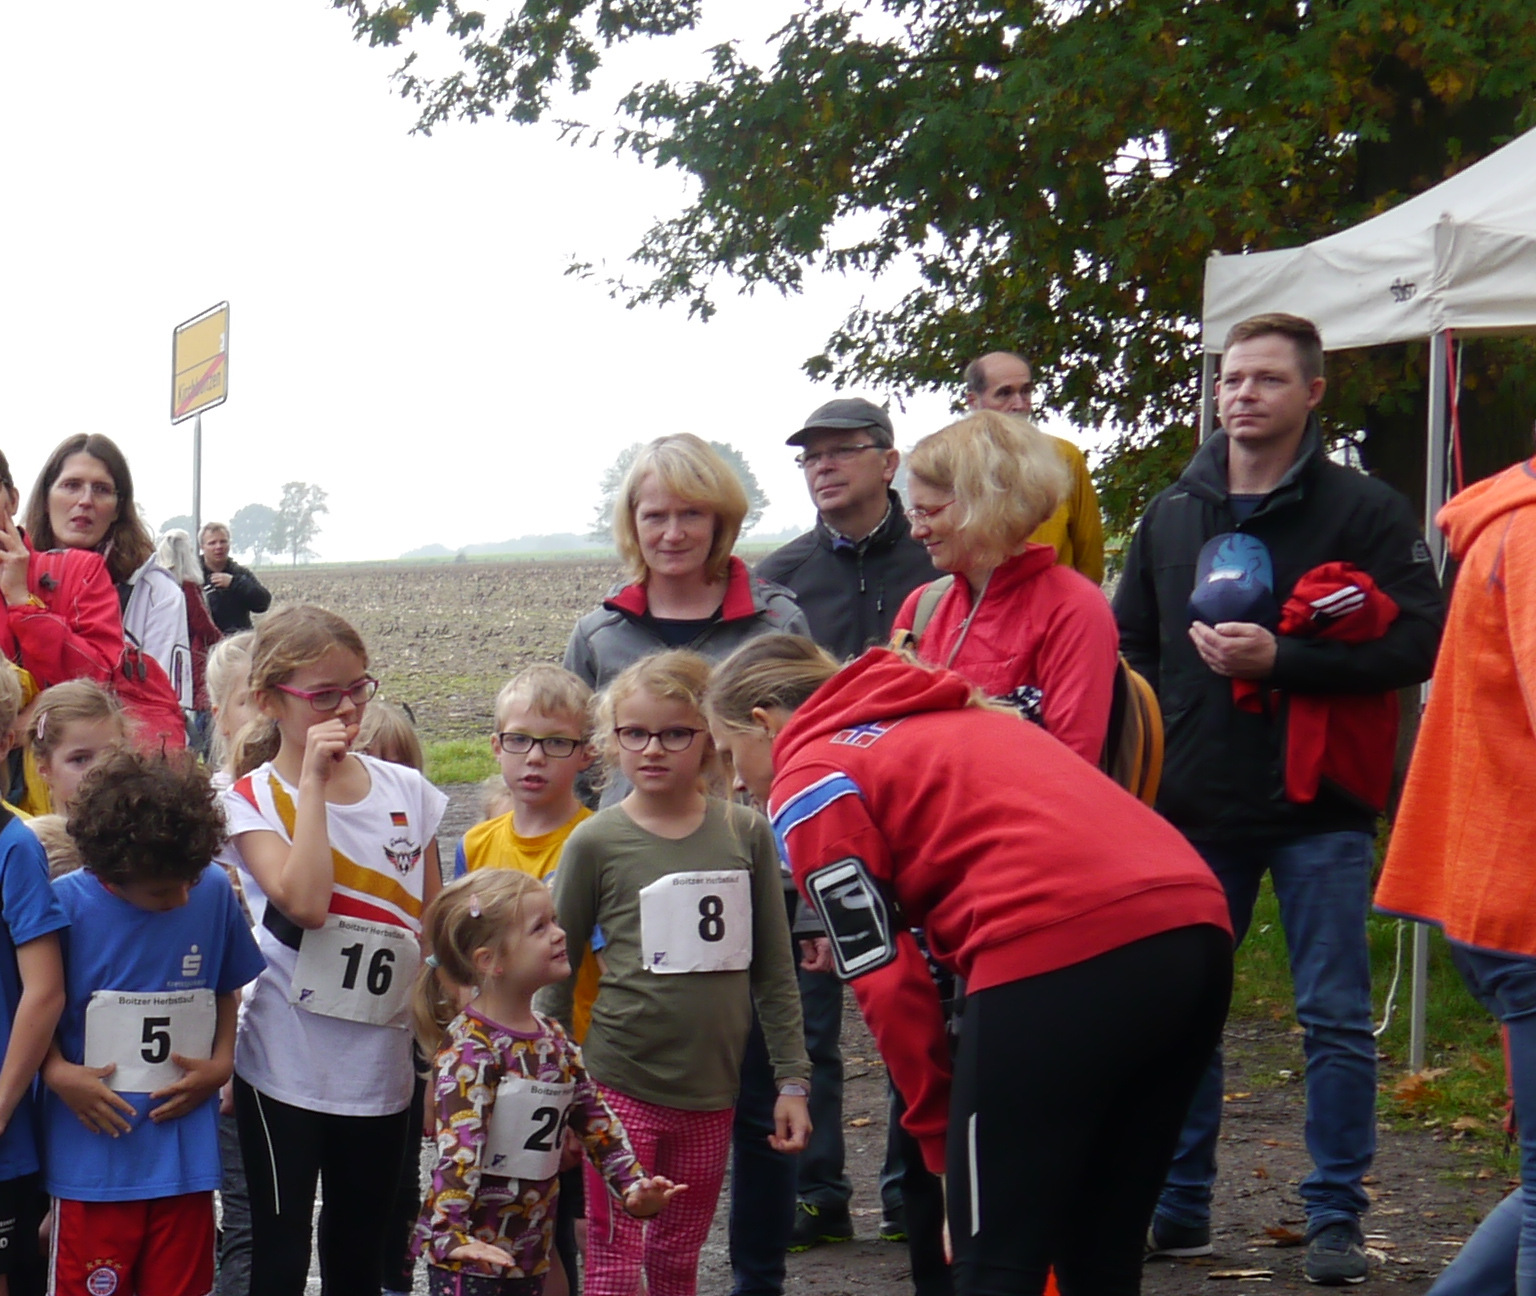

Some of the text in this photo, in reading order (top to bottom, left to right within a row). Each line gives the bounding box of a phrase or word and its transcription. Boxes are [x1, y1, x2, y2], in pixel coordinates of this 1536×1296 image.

[339, 920, 369, 933] Boitzer
[698, 895, 726, 942] 8
[340, 942, 396, 997] 16
[119, 996, 152, 1005] Boitzer
[141, 1016, 171, 1064] 5
